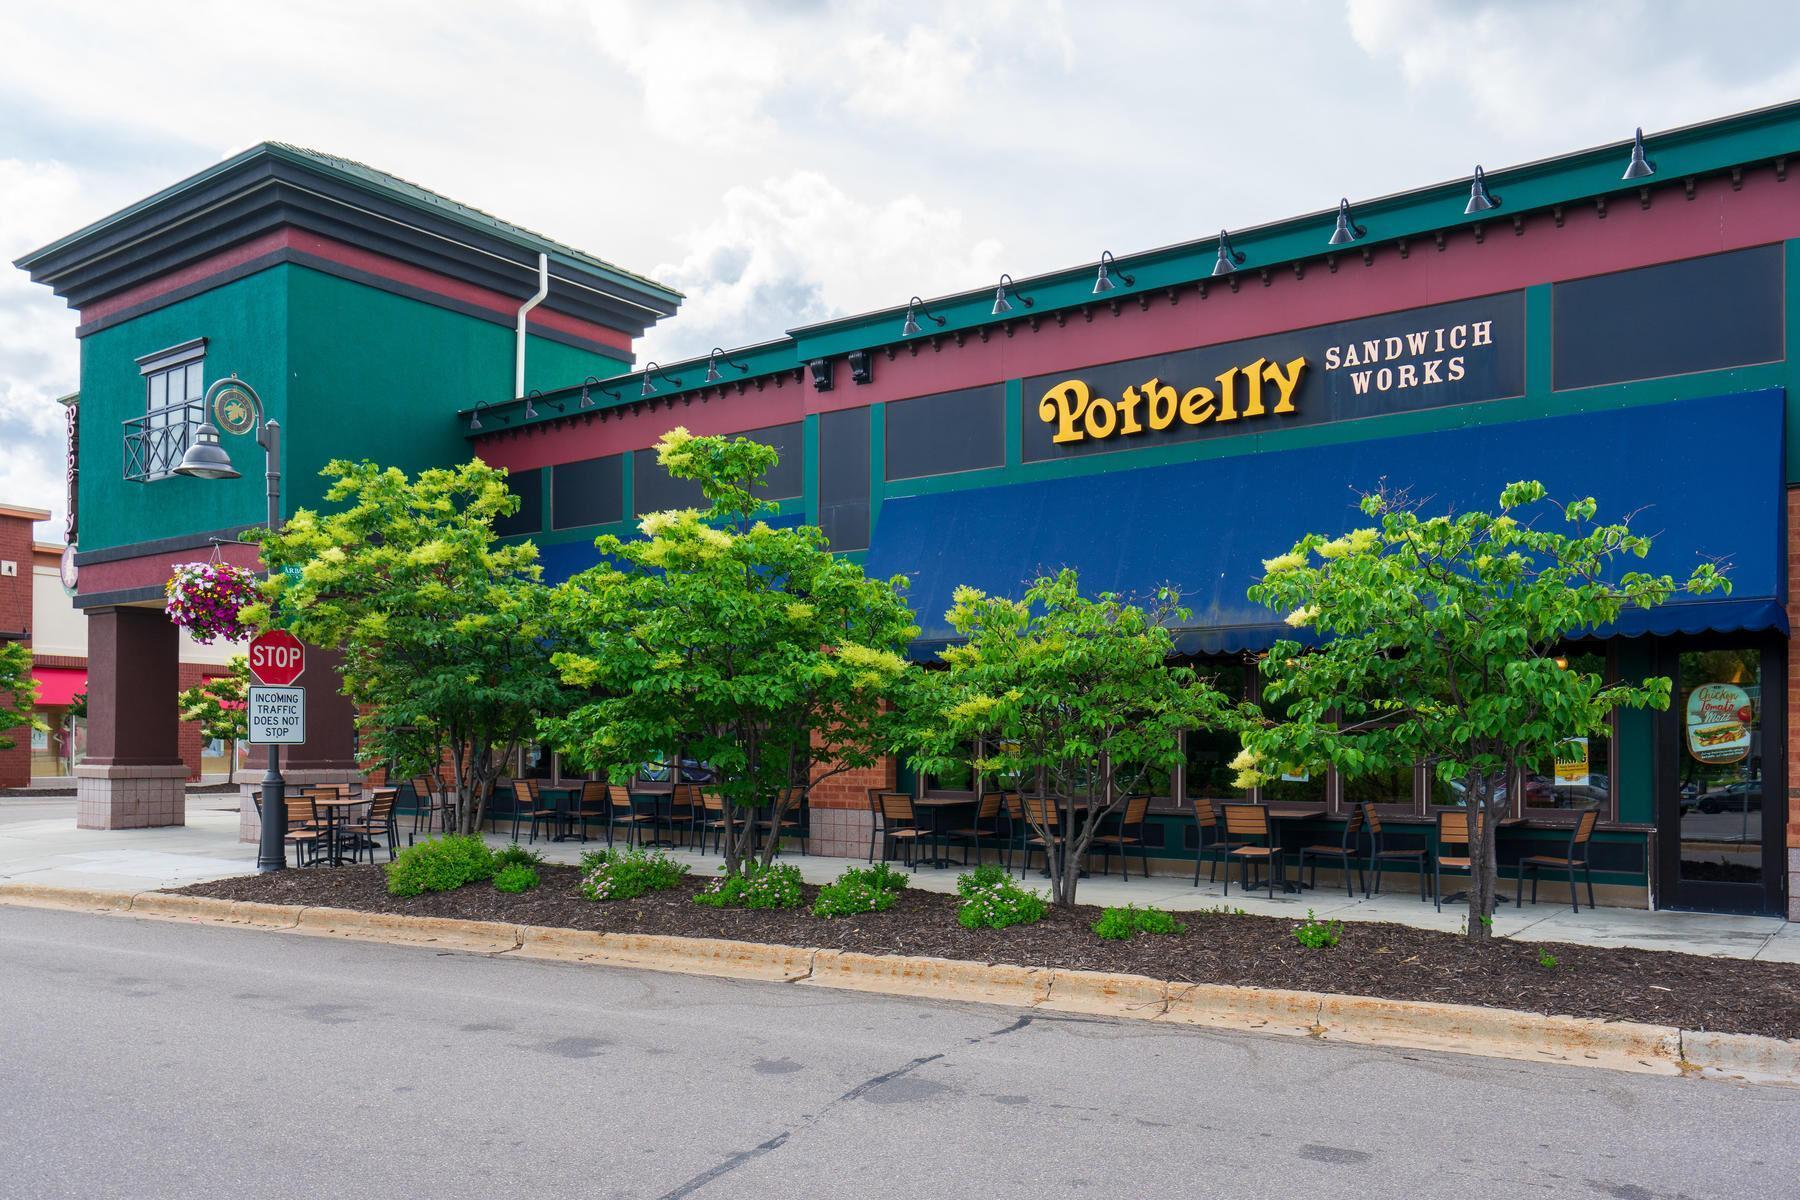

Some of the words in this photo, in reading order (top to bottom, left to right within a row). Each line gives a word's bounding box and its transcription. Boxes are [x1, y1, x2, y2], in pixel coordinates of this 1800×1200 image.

[1325, 320, 1493, 371] SANDWICH
[1350, 356, 1465, 395] WORKS
[1039, 356, 1306, 444] Potbelly
[252, 645, 301, 668] STOP
[255, 693, 299, 703] INCOMING
[257, 705, 297, 714] TRAFFIC
[253, 716, 279, 725] DOES
[282, 716, 300, 725] NOT
[265, 727, 289, 737] STOP
